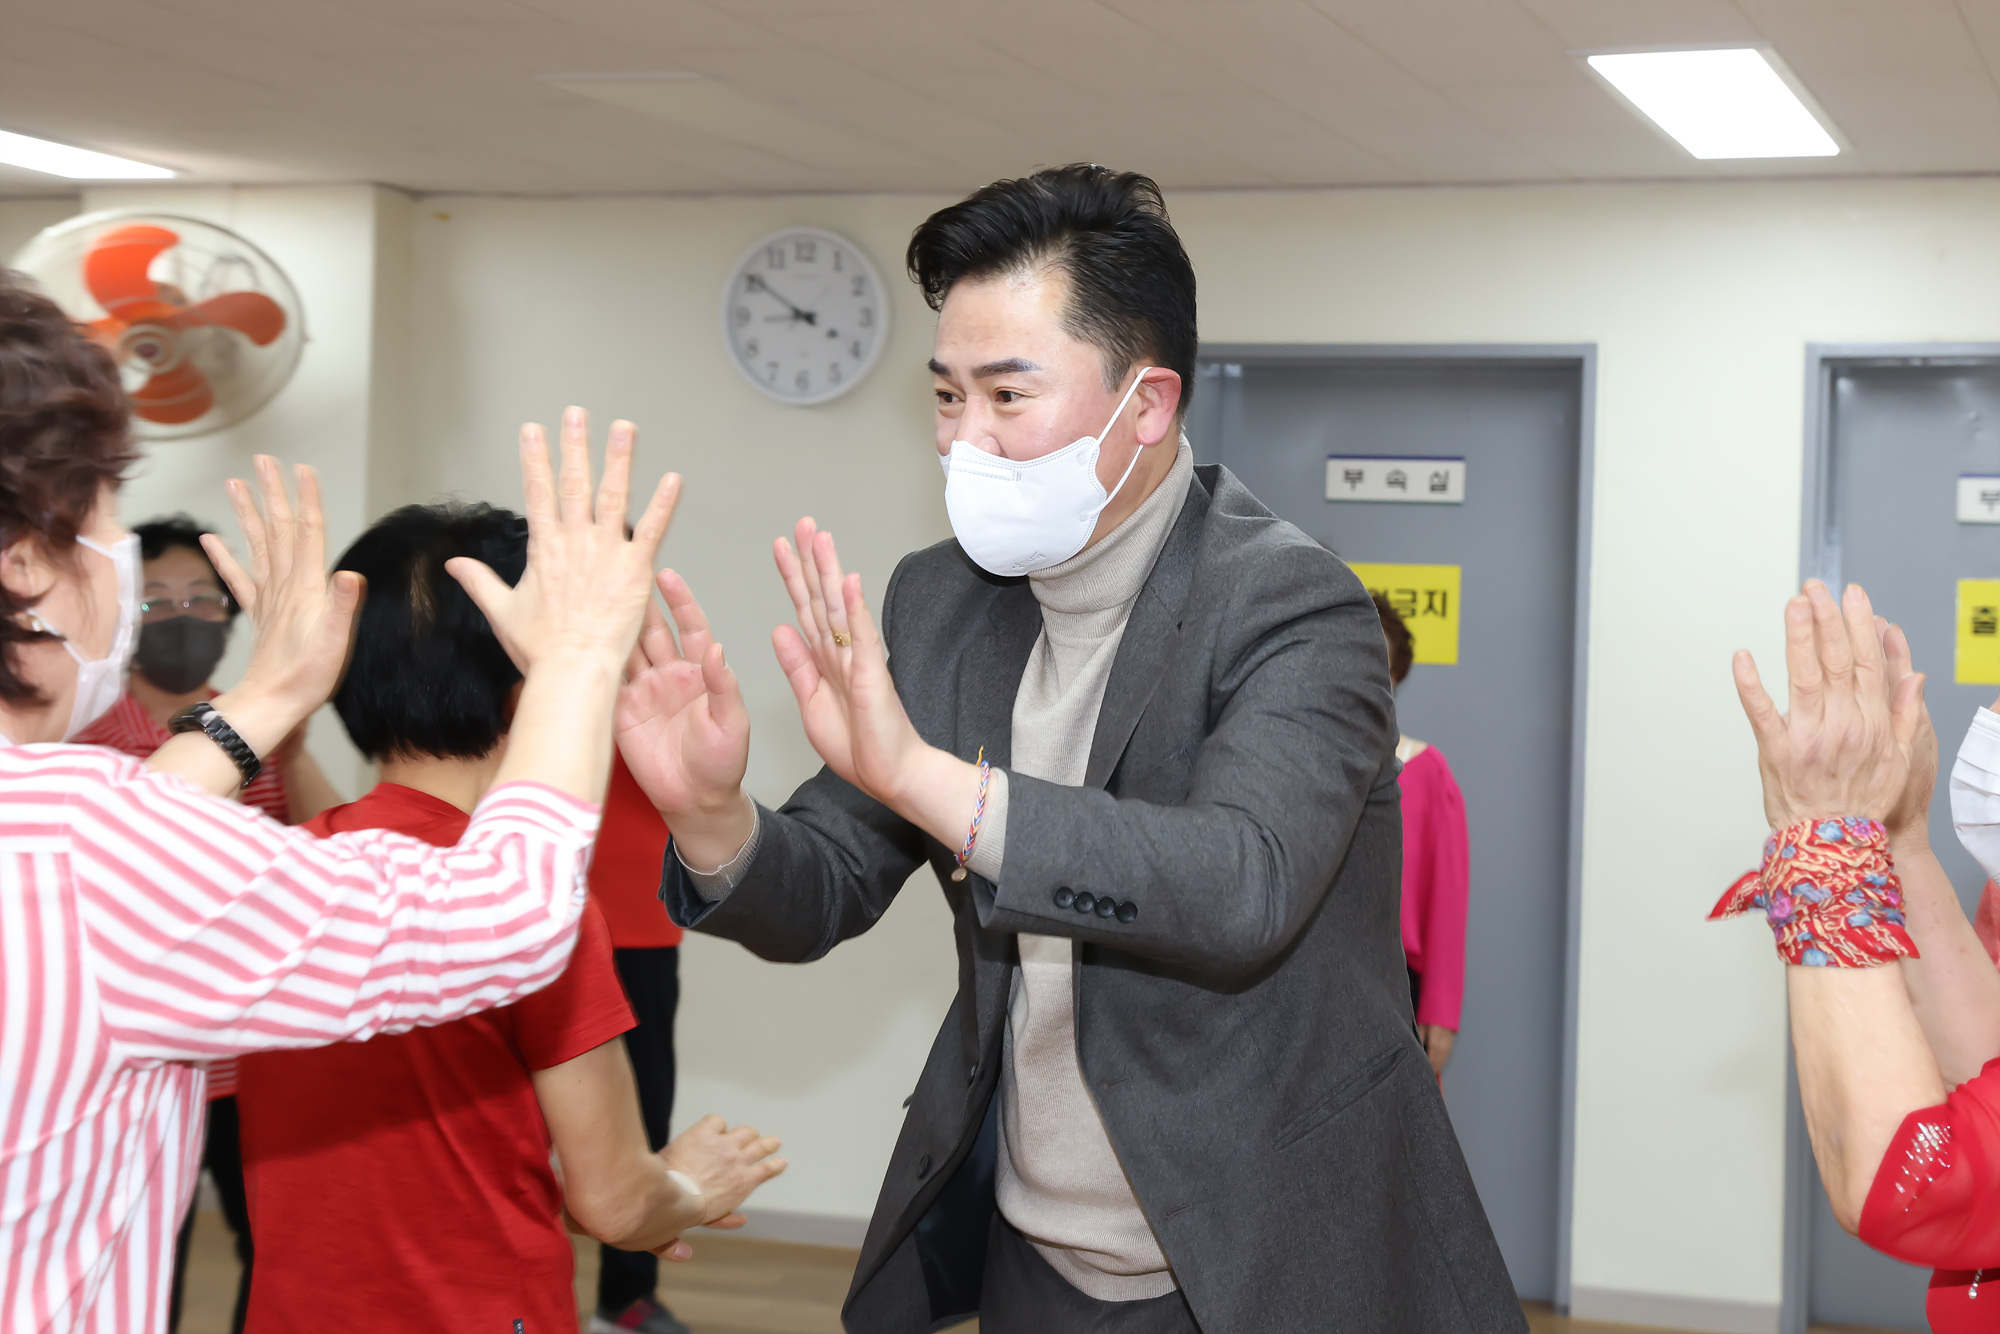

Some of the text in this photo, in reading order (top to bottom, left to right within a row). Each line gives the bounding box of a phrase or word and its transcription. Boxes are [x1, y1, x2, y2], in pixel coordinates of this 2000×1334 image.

[766, 246, 786, 270] 11
[795, 241, 817, 263] 12
[833, 250, 842, 273] 1
[851, 274, 866, 297] 2
[734, 305, 751, 328] 9
[859, 305, 874, 329] 3
[766, 360, 780, 383] 7
[795, 369, 810, 392] 6
[828, 361, 843, 385] 5
